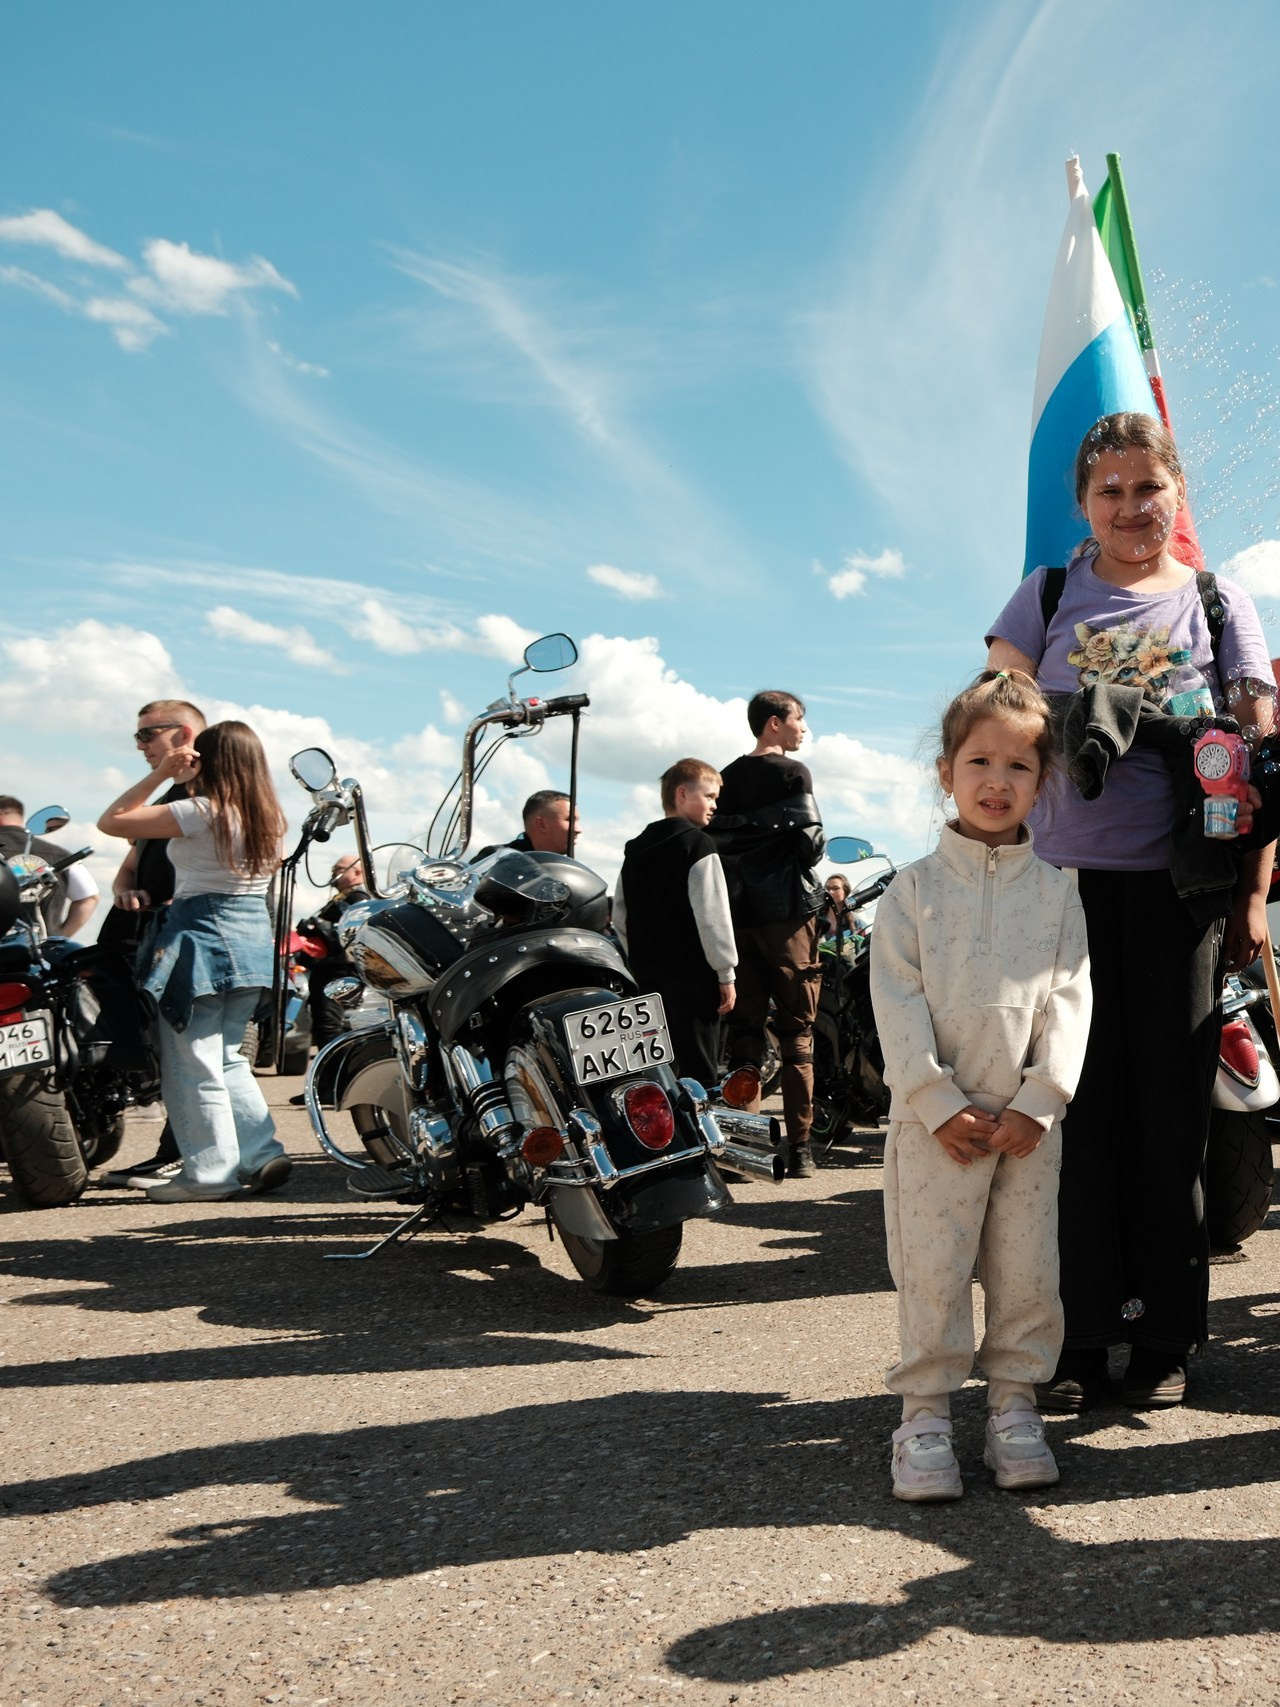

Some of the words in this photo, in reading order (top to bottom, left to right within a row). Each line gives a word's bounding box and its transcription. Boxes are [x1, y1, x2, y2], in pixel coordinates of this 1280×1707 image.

[581, 1002, 651, 1039] 6265
[620, 1031, 642, 1042] RUS
[18, 1045, 43, 1062] 16
[633, 1038, 665, 1064] 16
